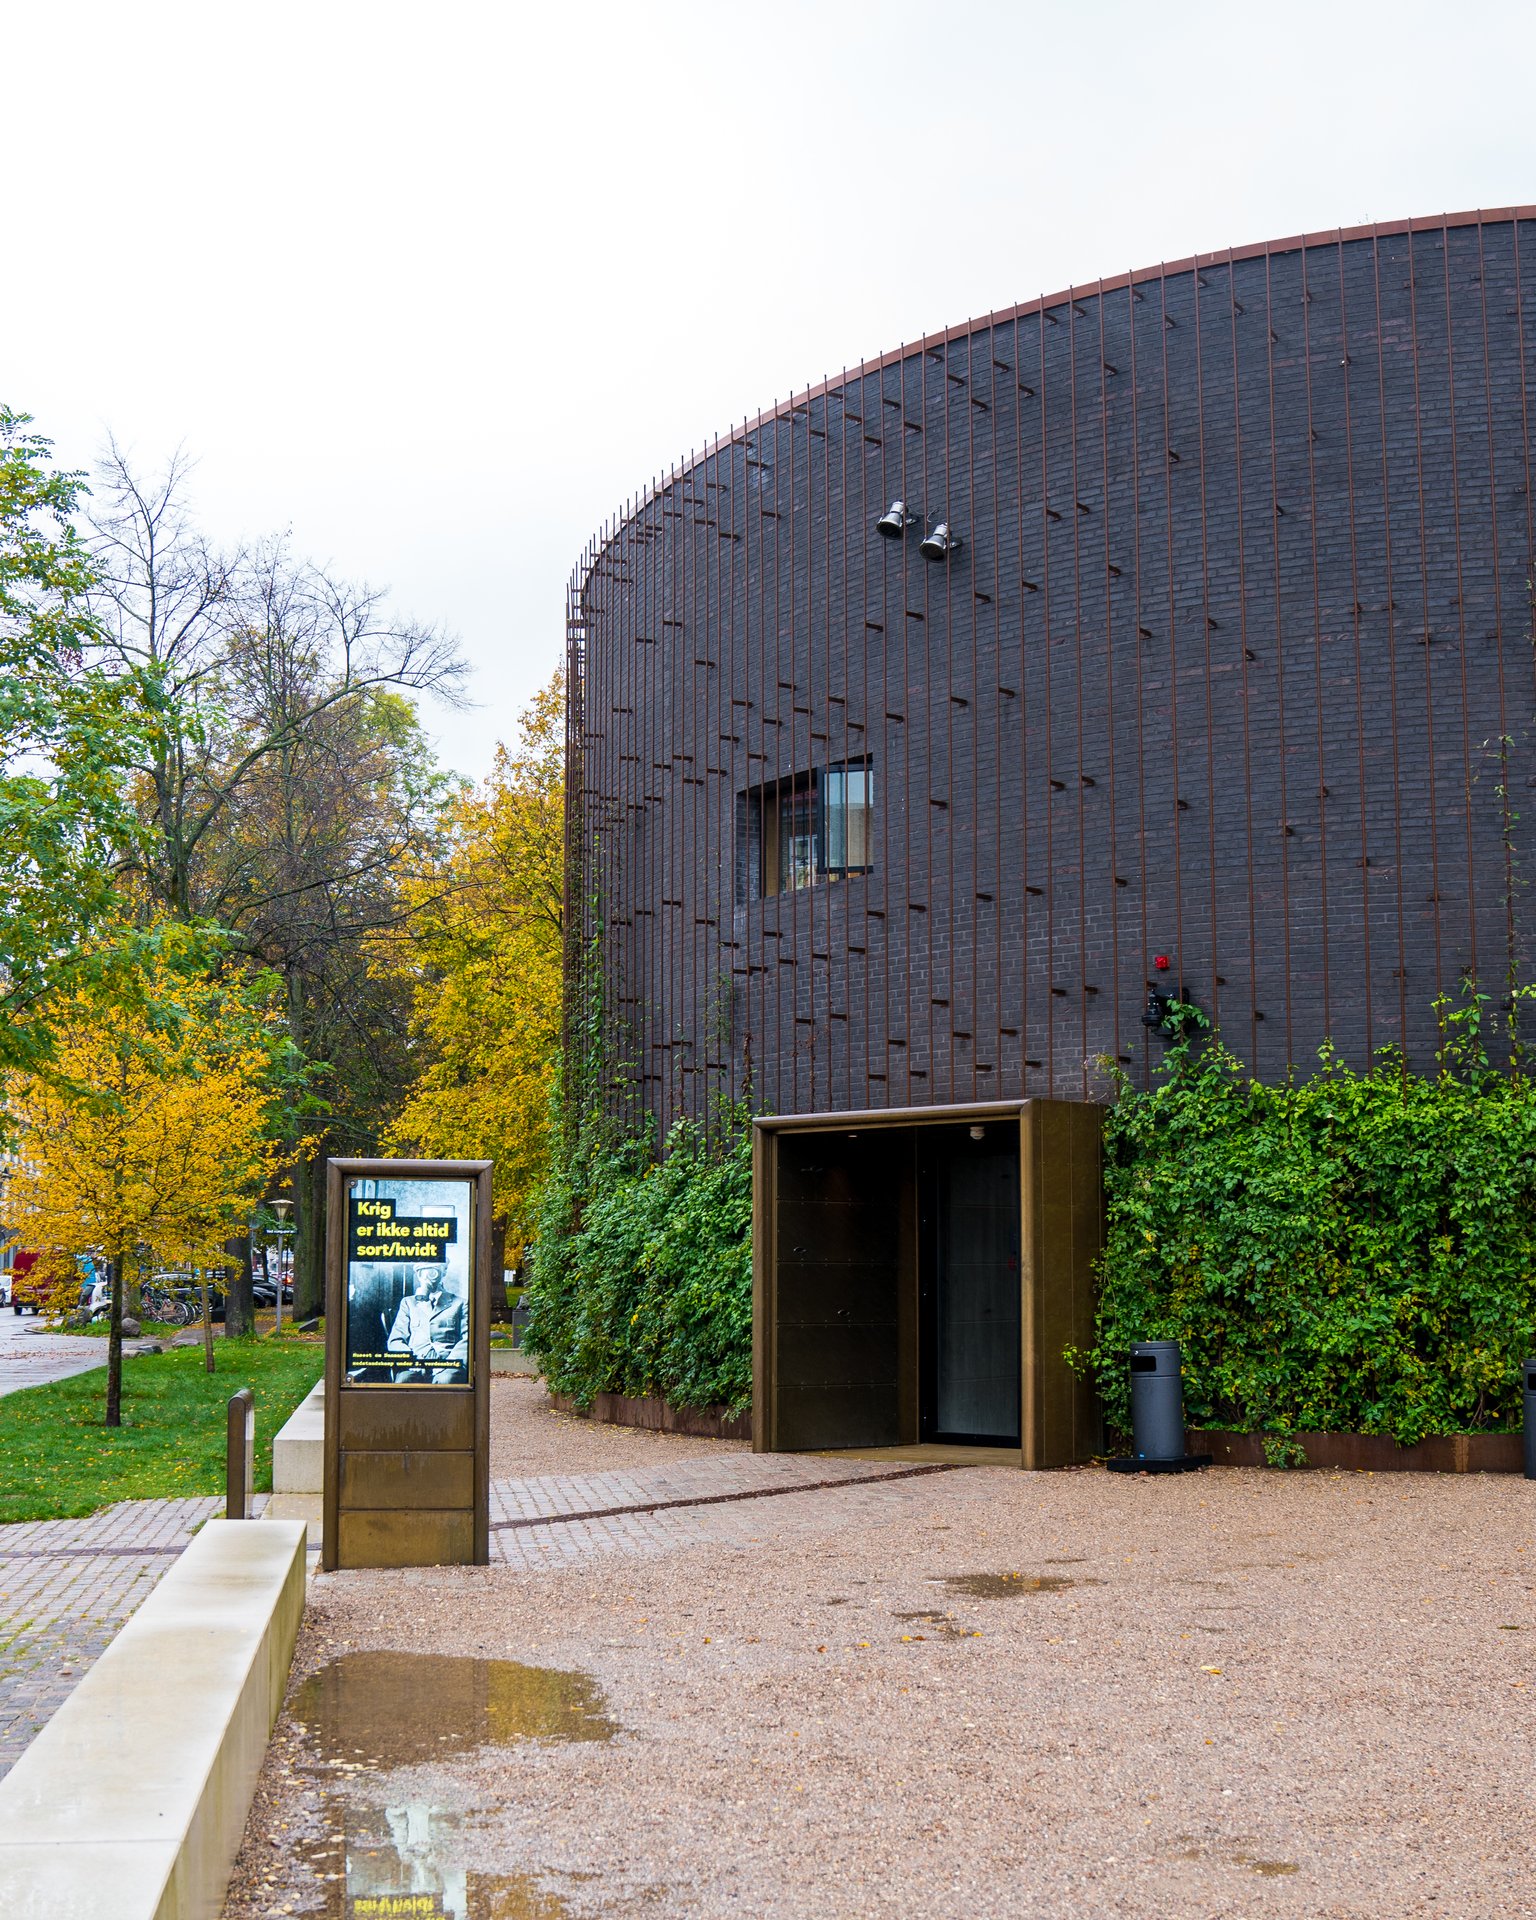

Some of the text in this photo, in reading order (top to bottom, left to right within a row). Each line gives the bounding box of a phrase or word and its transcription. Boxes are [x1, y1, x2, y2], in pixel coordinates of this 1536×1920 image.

[357, 1201, 391, 1219] Krig
[356, 1222, 449, 1237] er ikke altid
[356, 1242, 437, 1257] sort/hvidt
